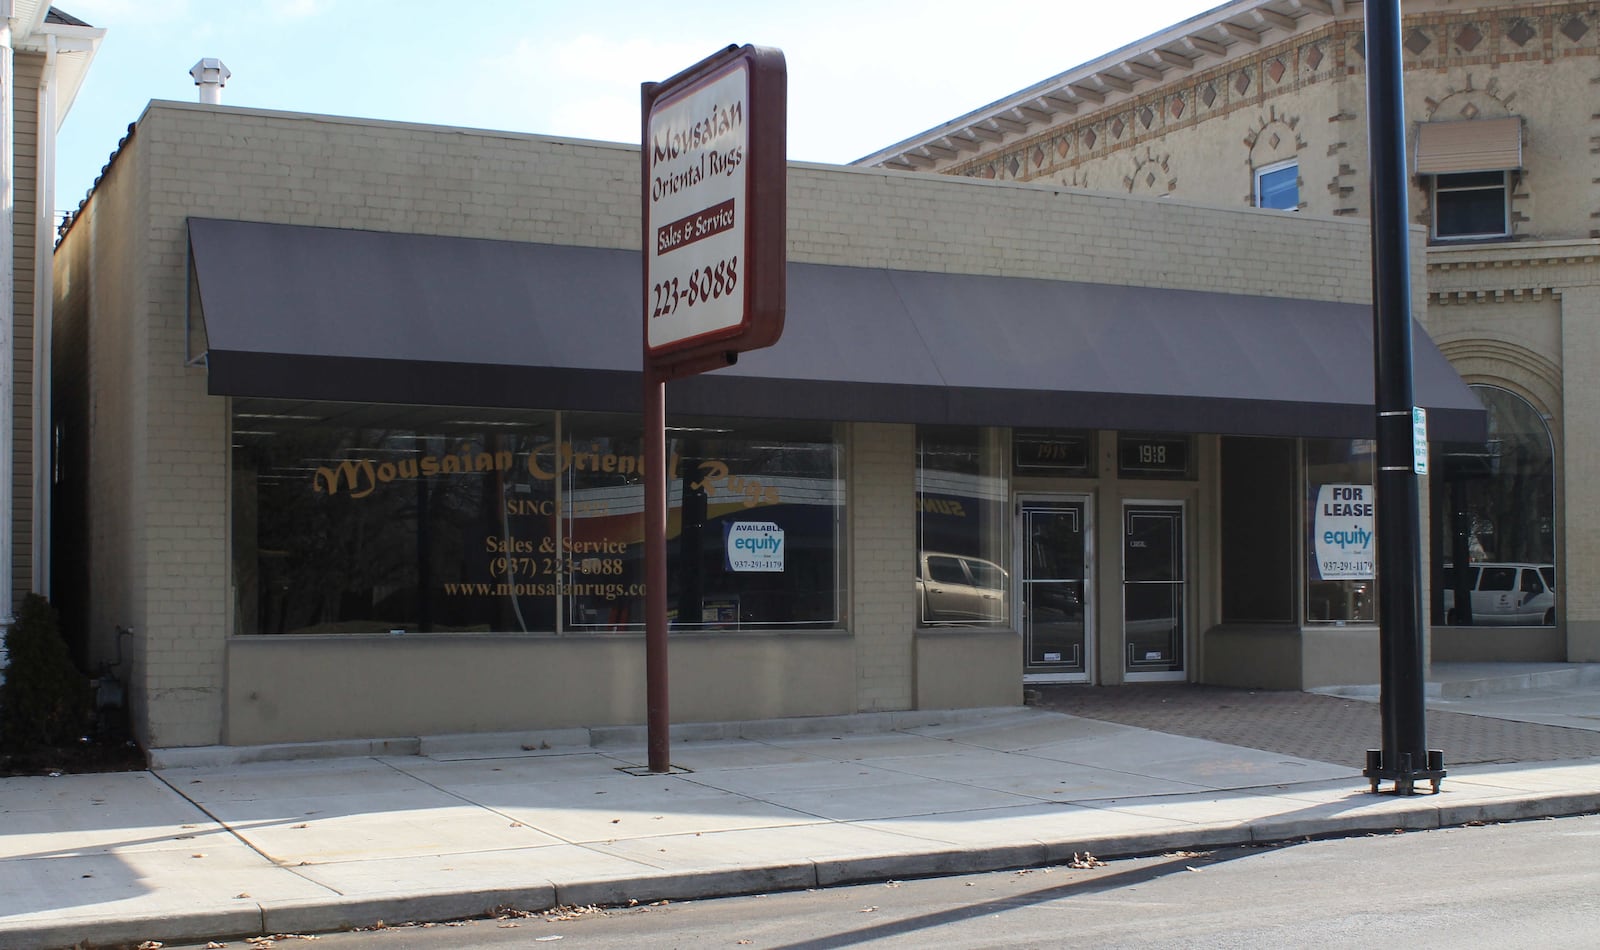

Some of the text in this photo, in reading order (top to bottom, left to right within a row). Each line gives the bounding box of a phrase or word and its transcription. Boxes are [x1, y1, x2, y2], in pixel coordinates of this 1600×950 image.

[654, 100, 742, 168] Mousaian
[653, 145, 742, 202] Oriental Rugs
[659, 208, 734, 251] Sales & Service
[653, 255, 738, 318] 223-8088
[313, 443, 513, 499] Mousaian
[690, 460, 779, 508] Rugs
[1333, 487, 1363, 501] FOR
[1324, 503, 1373, 516] LEASE
[486, 536, 627, 553] Sales & Service
[735, 533, 781, 553] equity
[1323, 525, 1372, 549] equity
[489, 558, 624, 578] (937) 223-8088
[734, 560, 782, 568] 937-291-1179
[1323, 561, 1374, 572] 937-291-1179
